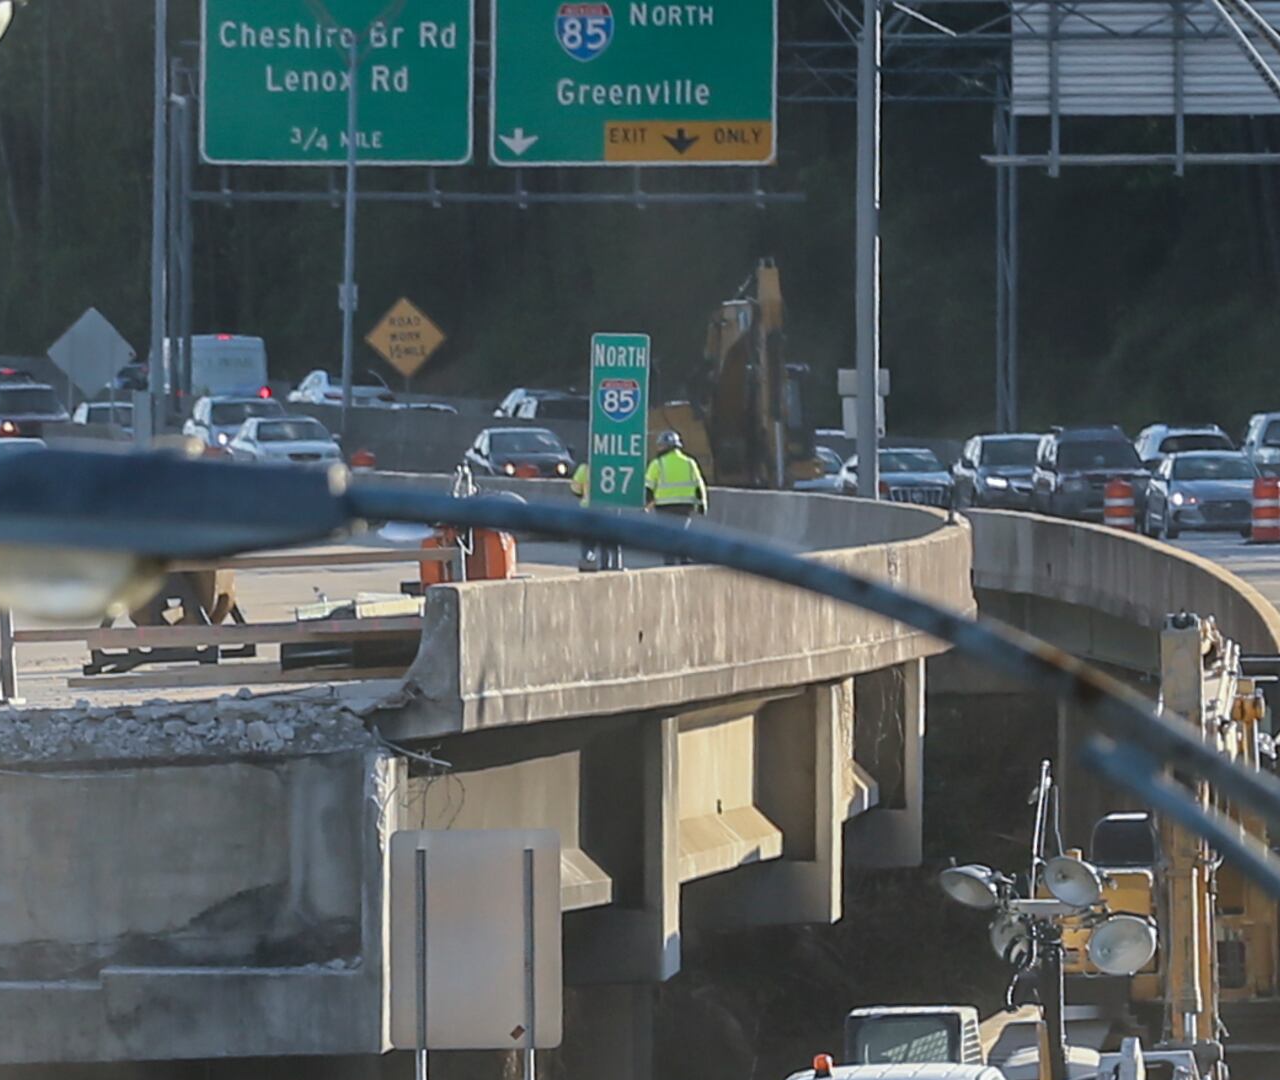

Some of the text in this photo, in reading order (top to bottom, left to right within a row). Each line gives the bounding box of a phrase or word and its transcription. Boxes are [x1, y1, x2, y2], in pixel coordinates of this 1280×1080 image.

[630, 3, 713, 26] NORTH
[219, 21, 457, 48] Cheshire Br Rd
[563, 18, 606, 49] 85
[265, 65, 408, 92] Lenox Rd
[556, 78, 711, 105] Greenville
[609, 128, 762, 144] EXIT ONLY
[388, 315, 421, 327] ROAD
[389, 331, 420, 342] WORK
[594, 343, 646, 367] NORTH
[604, 390, 634, 412] 85
[593, 434, 642, 456] MILE
[600, 466, 634, 494] 87
